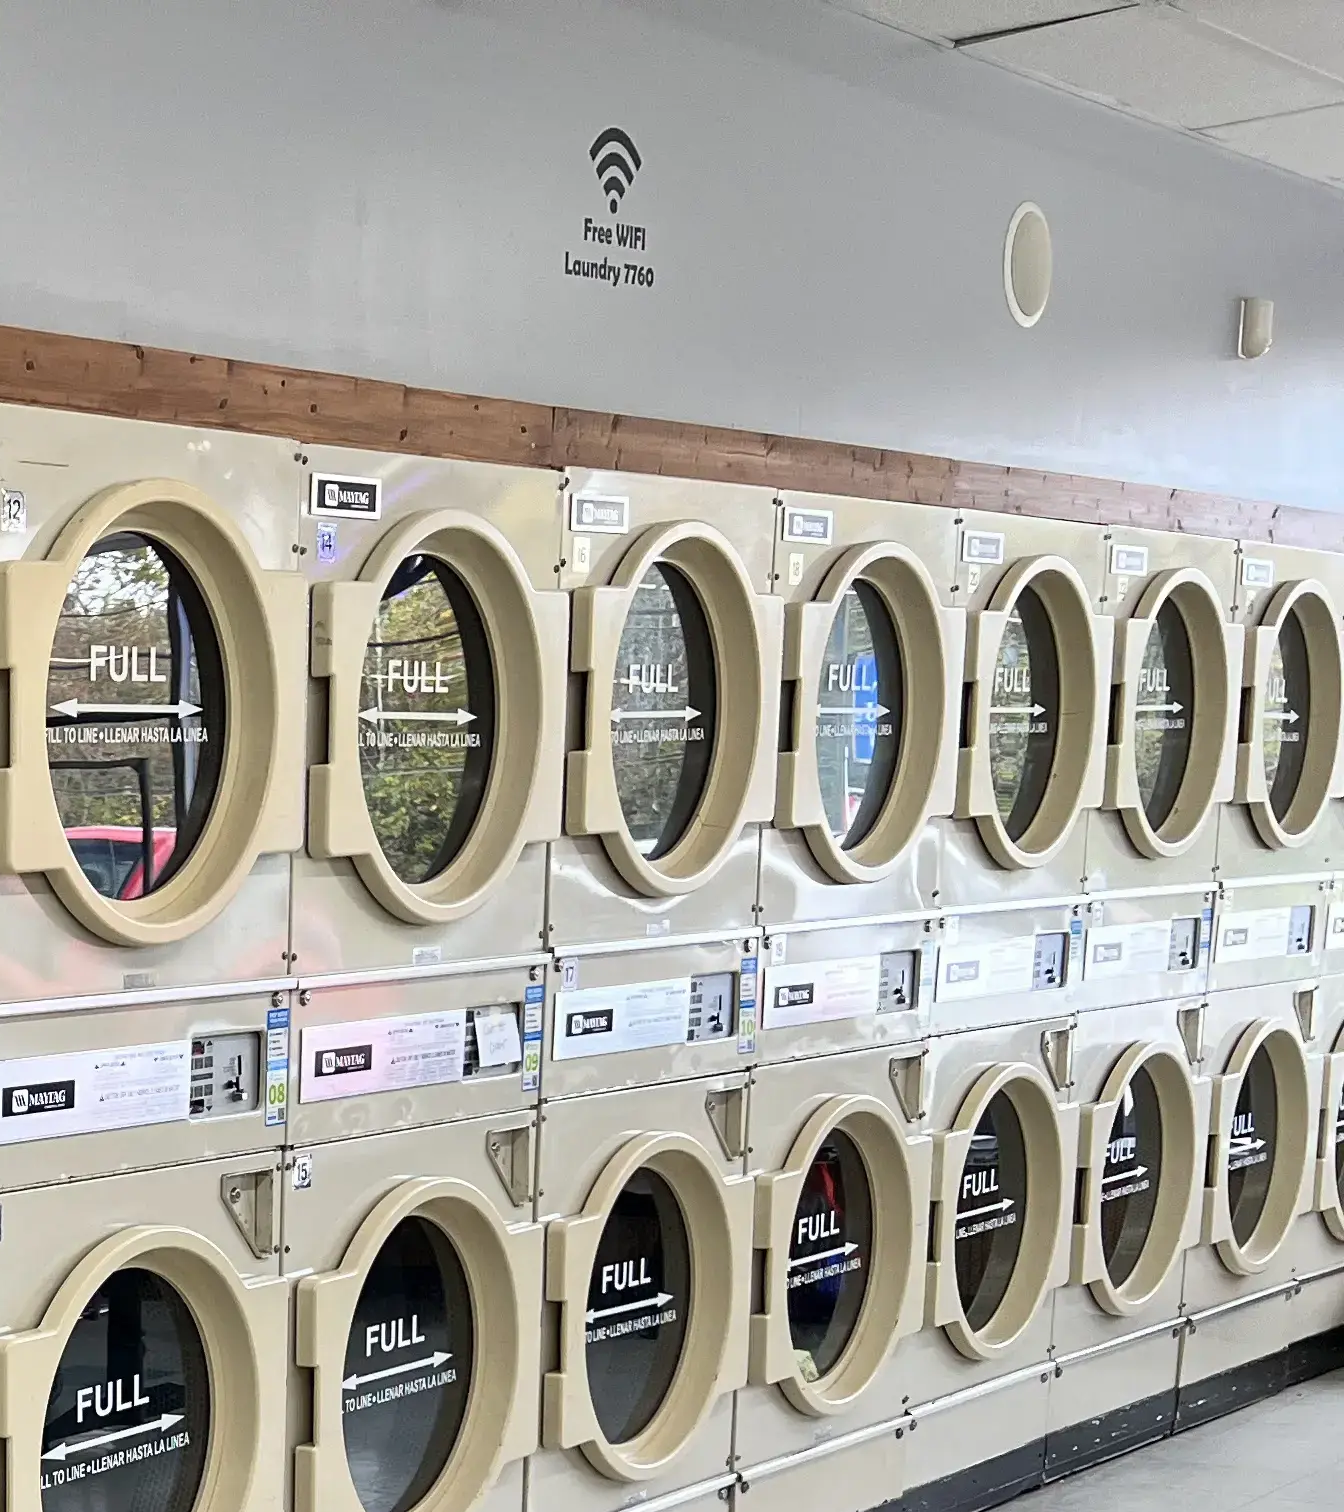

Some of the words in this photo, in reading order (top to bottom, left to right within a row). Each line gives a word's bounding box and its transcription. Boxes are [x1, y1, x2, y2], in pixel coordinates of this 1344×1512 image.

[584, 217, 613, 245] Free
[565, 251, 621, 287] Laundry
[624, 263, 654, 288] 7760
[7, 499, 20, 520] 12
[90, 644, 167, 682] FULL
[388, 659, 449, 693] FULL
[828, 664, 872, 692] FULL
[628, 664, 679, 694] FULL
[995, 667, 1030, 692] FULL
[1139, 668, 1170, 692] FULL
[64, 728, 77, 743] TO
[78, 728, 98, 743] LINE
[105, 728, 140, 743] LLENAR
[141, 728, 169, 743] HASTA
[171, 728, 182, 743] LA
[183, 727, 209, 743] LINEA
[565, 966, 574, 982] 17
[29, 1090, 66, 1107] MAYTAG
[269, 1083, 285, 1105] 08
[297, 1163, 307, 1181] 15
[963, 1169, 999, 1199] FULL
[798, 1210, 840, 1244] FULL
[602, 1257, 651, 1294] FULL
[366, 1314, 425, 1357] FULL
[77, 1374, 149, 1423] FULL
[345, 1398, 356, 1413] TO
[356, 1393, 372, 1410] LINE
[377, 1384, 404, 1403] LLENAR
[405, 1377, 426, 1395] HASTA
[427, 1375, 436, 1388] LA
[437, 1369, 456, 1385] LINEA
[53, 1470, 64, 1486] TO
[66, 1463, 86, 1482] LINE
[91, 1451, 125, 1474] LLENAR
[126, 1444, 153, 1463] HASTA
[154, 1441, 165, 1455] LA
[166, 1432, 189, 1452] LINEA
